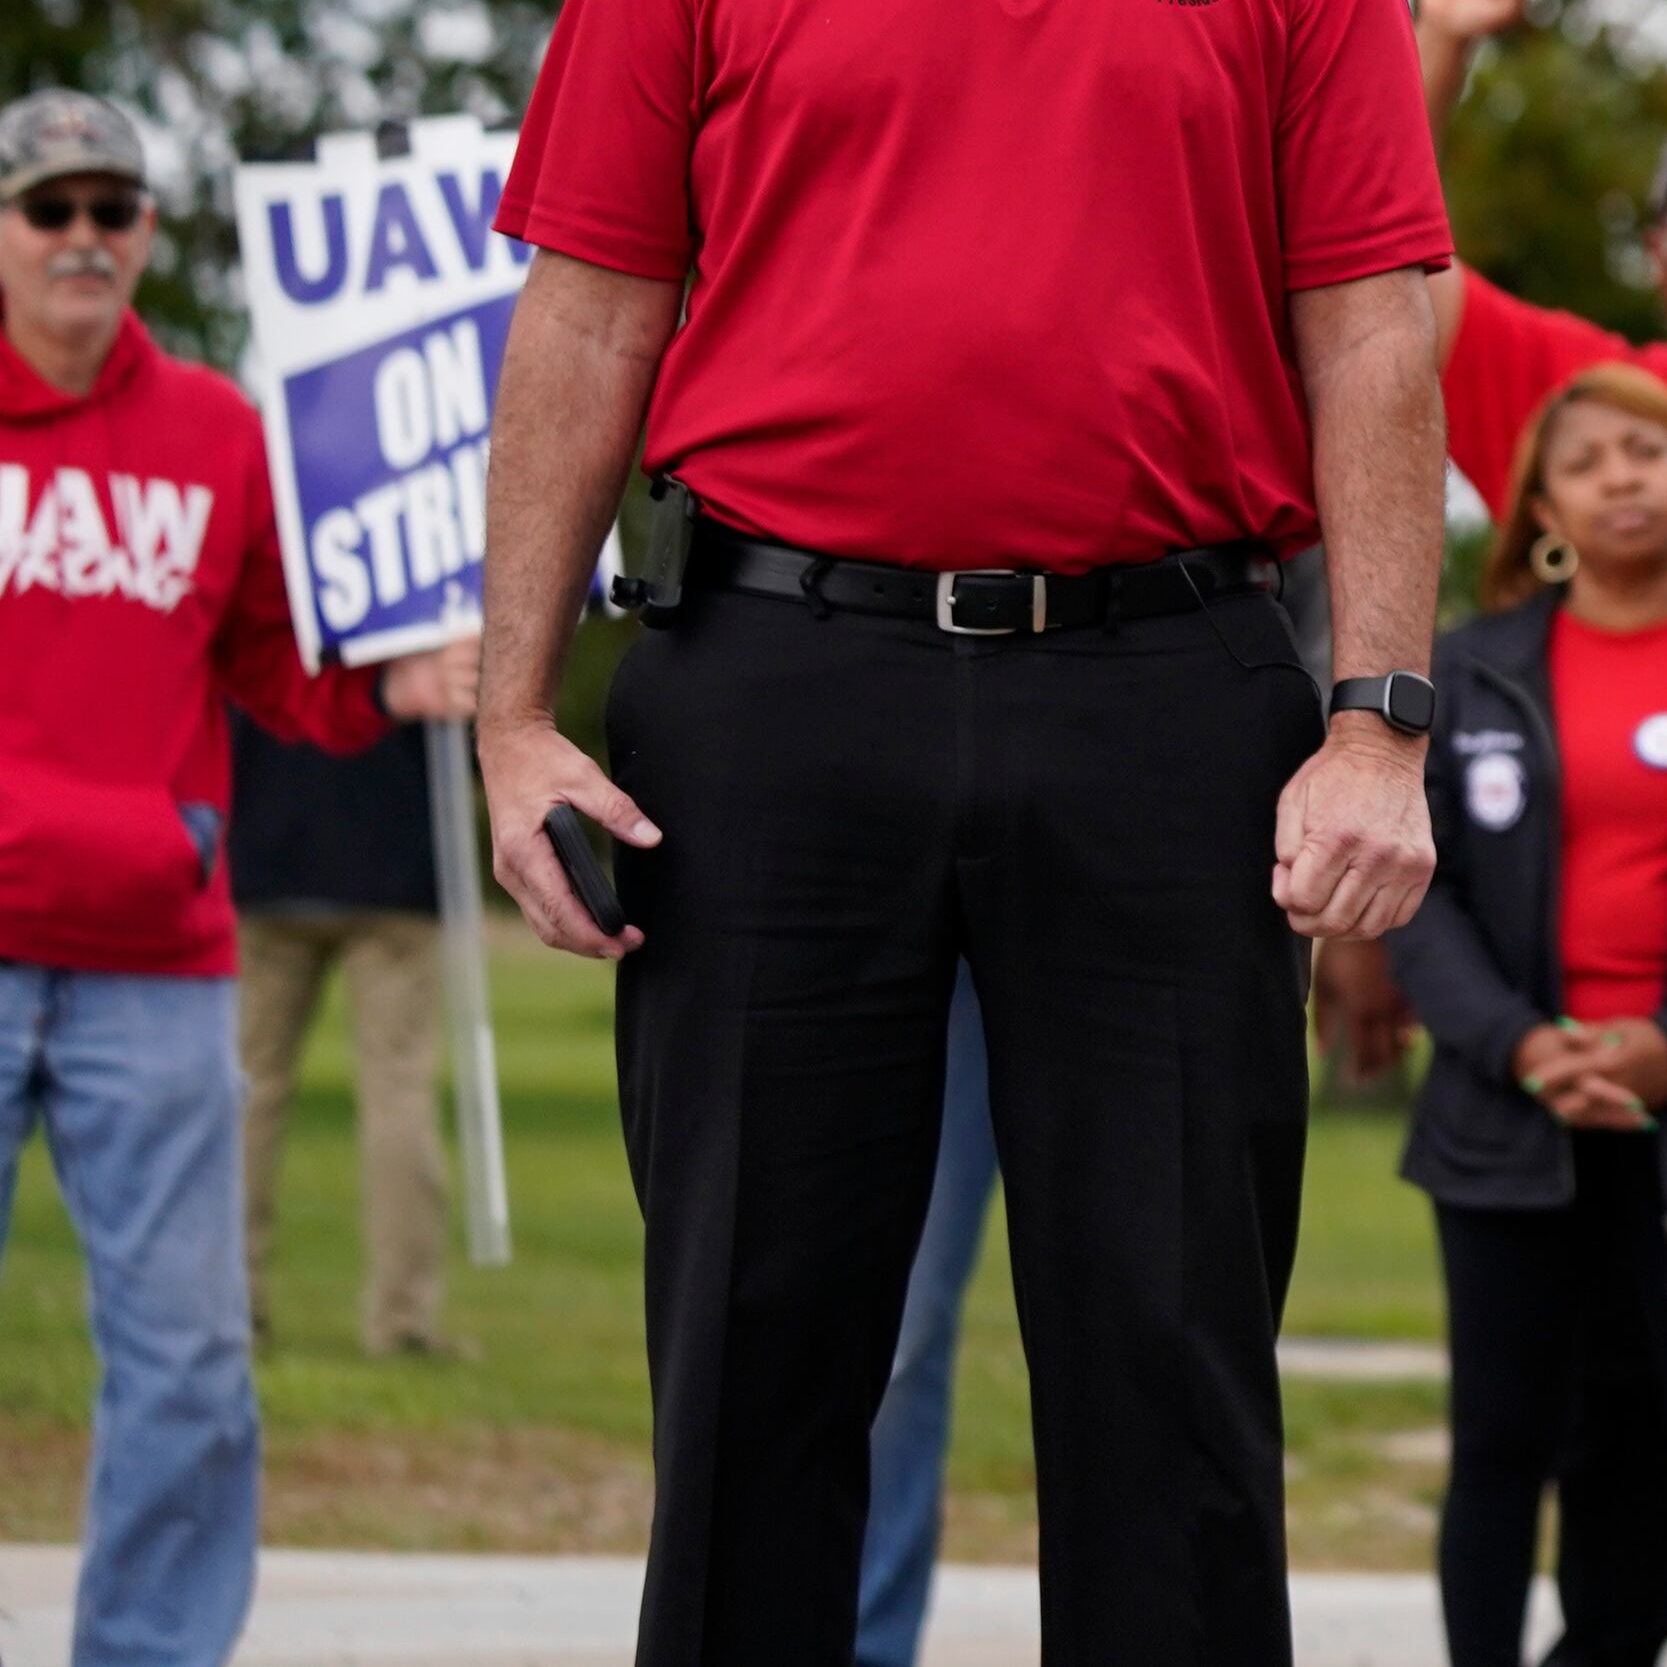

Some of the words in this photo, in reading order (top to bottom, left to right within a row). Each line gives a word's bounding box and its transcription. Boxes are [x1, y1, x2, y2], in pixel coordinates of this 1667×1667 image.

[267, 168, 534, 305] UAW
[374, 317, 489, 472] ON
[311, 440, 490, 633] STRI
